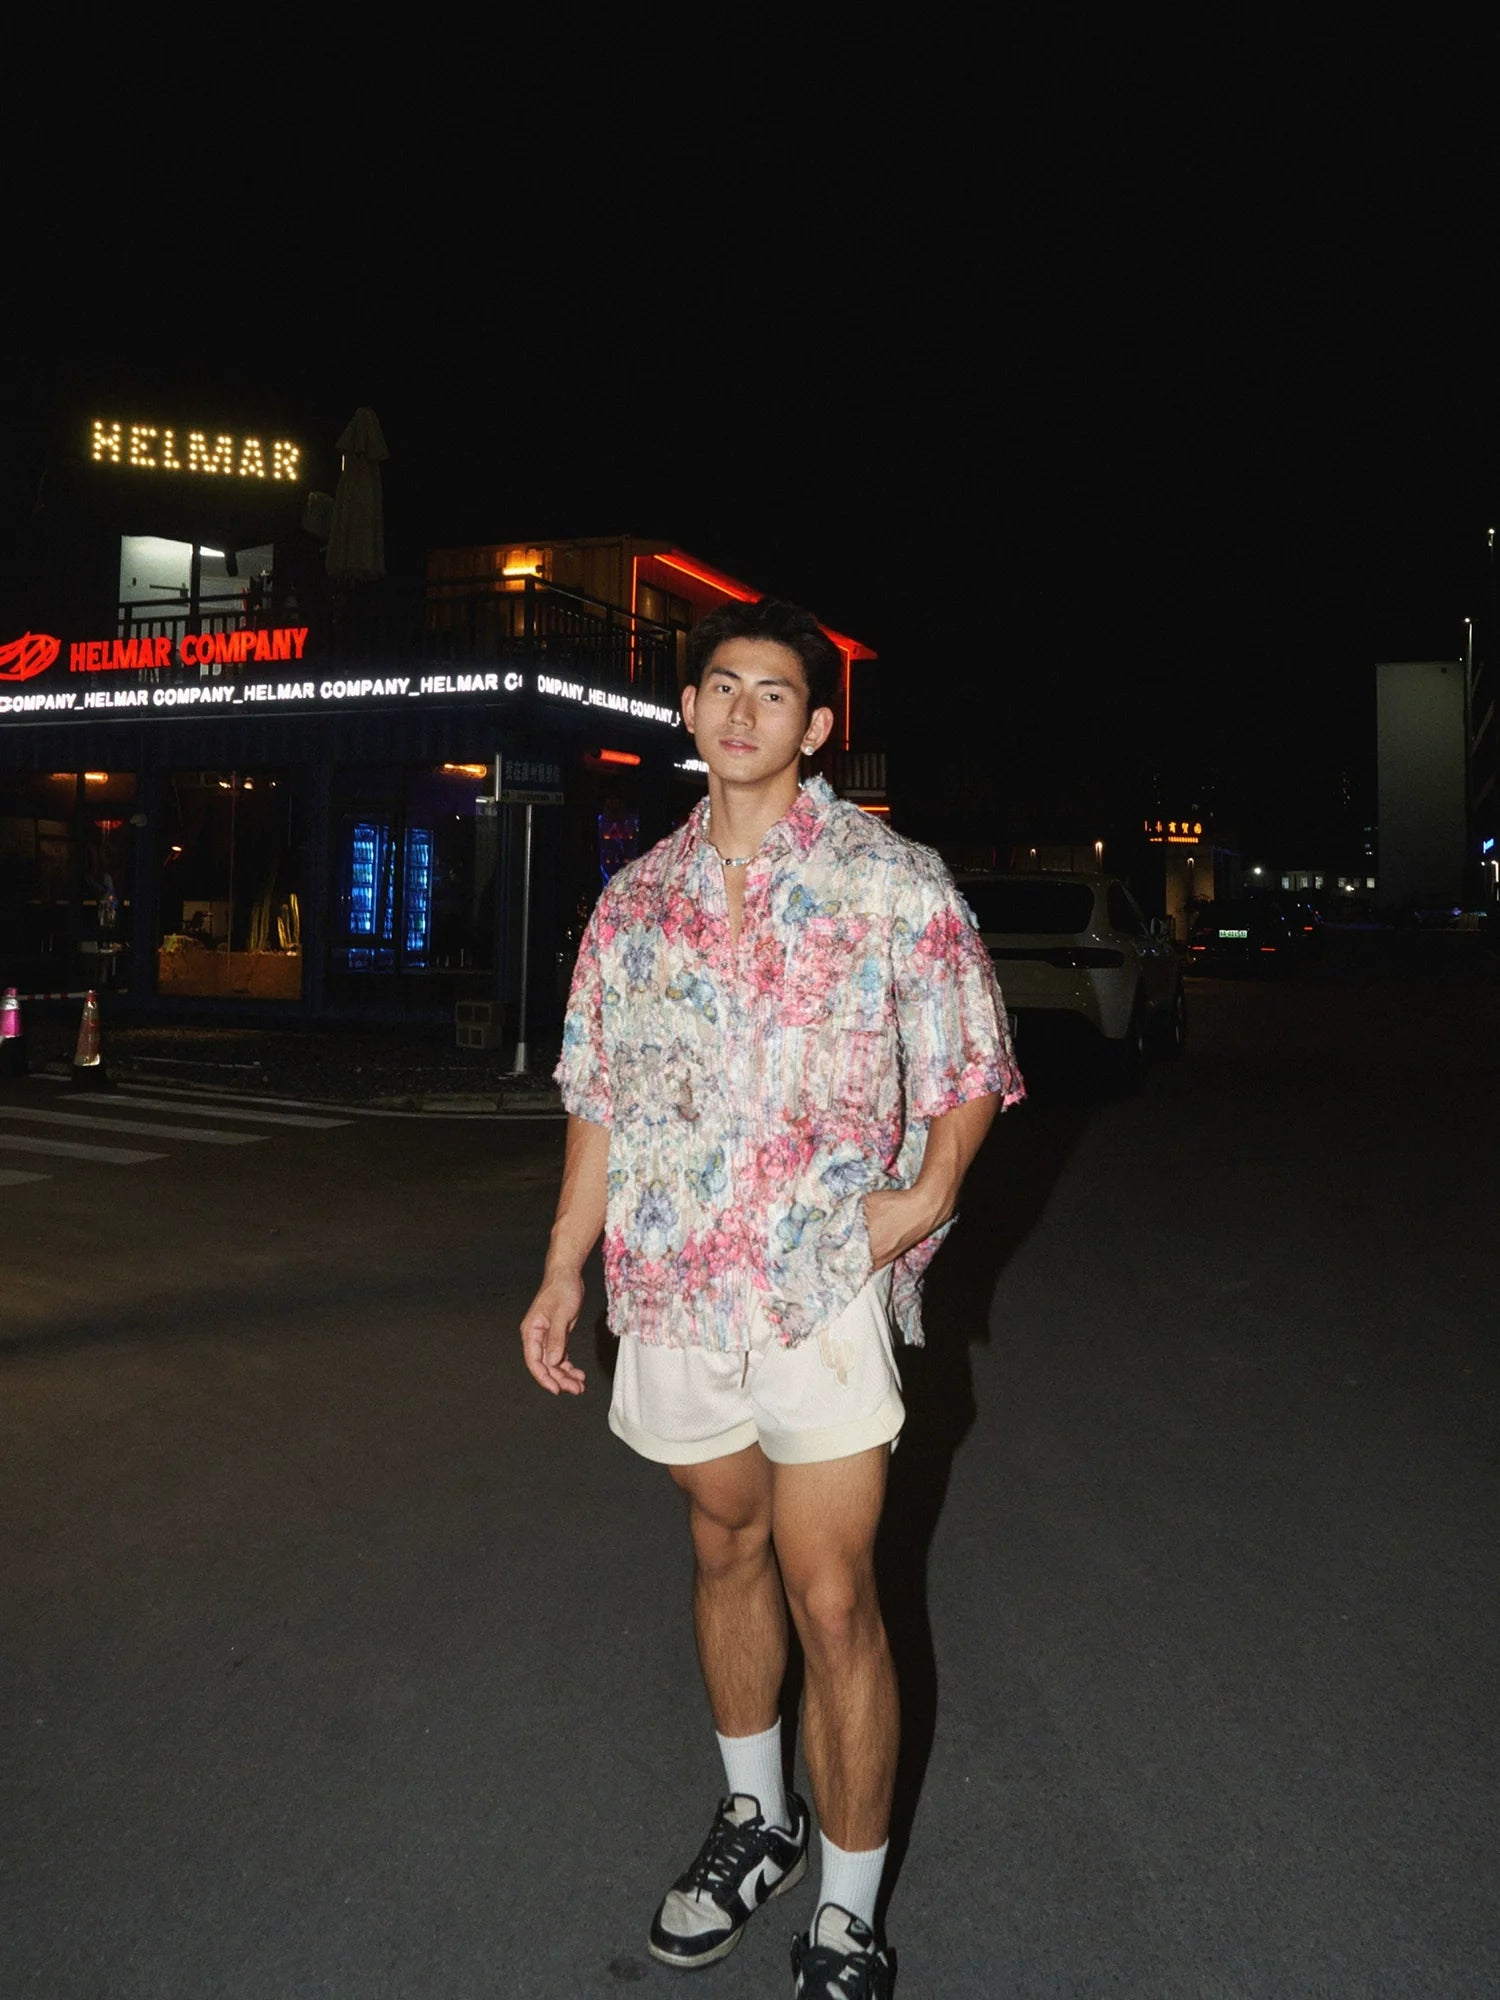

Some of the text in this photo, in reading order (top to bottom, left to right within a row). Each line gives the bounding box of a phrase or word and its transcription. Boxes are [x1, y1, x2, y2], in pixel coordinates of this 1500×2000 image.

[91, 419, 301, 482] HELMAR
[70, 628, 309, 672] HELMAR COMPANY
[153, 682, 314, 706] COMPANY_HELMAR
[320, 673, 499, 698] COMPANY_HELMAR
[504, 672, 523, 691] C
